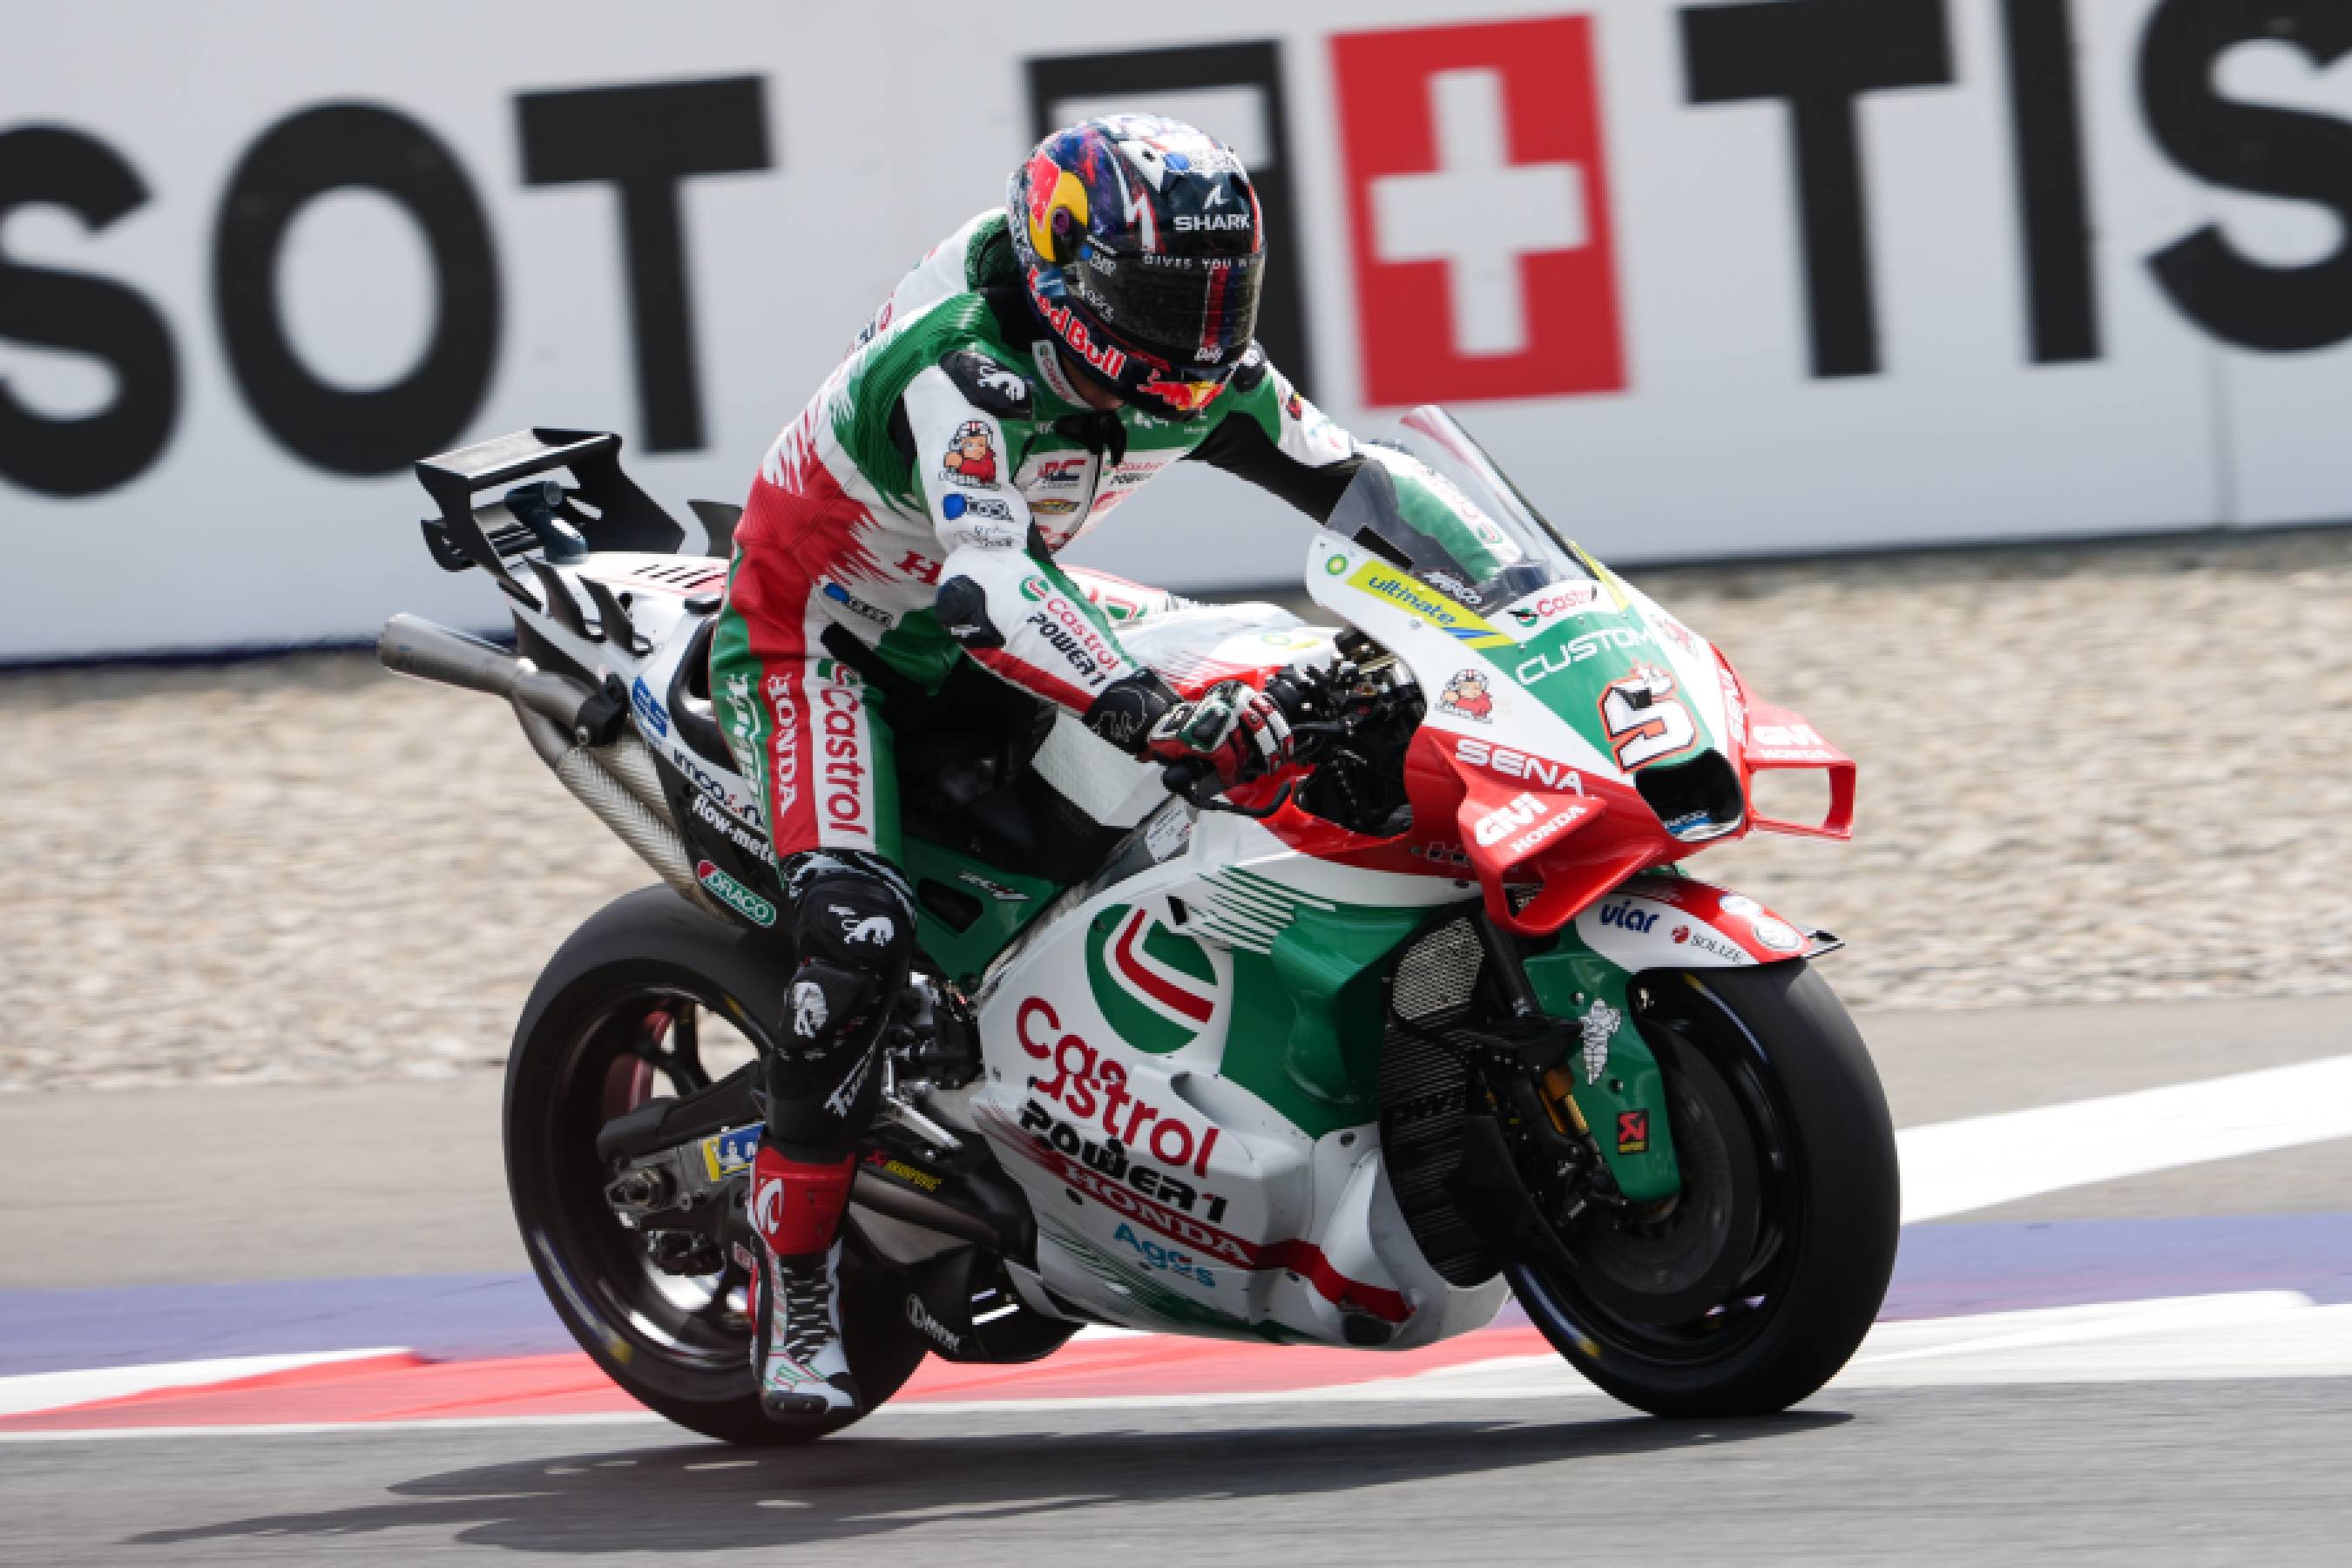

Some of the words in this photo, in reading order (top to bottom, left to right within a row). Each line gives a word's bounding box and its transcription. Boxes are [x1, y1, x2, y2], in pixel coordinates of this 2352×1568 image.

[1173, 213, 1251, 231] SHARK
[0, 72, 774, 499] SOT
[1143, 254, 1193, 269] GIVES
[1201, 257, 1232, 270] YOU
[1066, 316, 1127, 381] Bull
[1368, 576, 1456, 625] ultimate
[1536, 585, 1598, 618] Cast
[1046, 598, 1121, 671] Castrol
[767, 672, 798, 818] HONDA
[821, 688, 869, 836] Castrol
[1456, 739, 1585, 798] SENA
[692, 794, 777, 865] flow-mete
[1474, 791, 1549, 848] GIVI
[1510, 821, 1589, 854] HONDA
[708, 873, 770, 922] DRACO
[1599, 899, 1660, 934] viar
[1017, 996, 1220, 1179] Castrol
[1062, 1164, 1256, 1266] HONDA
[1114, 1222, 1216, 1288] Agos
